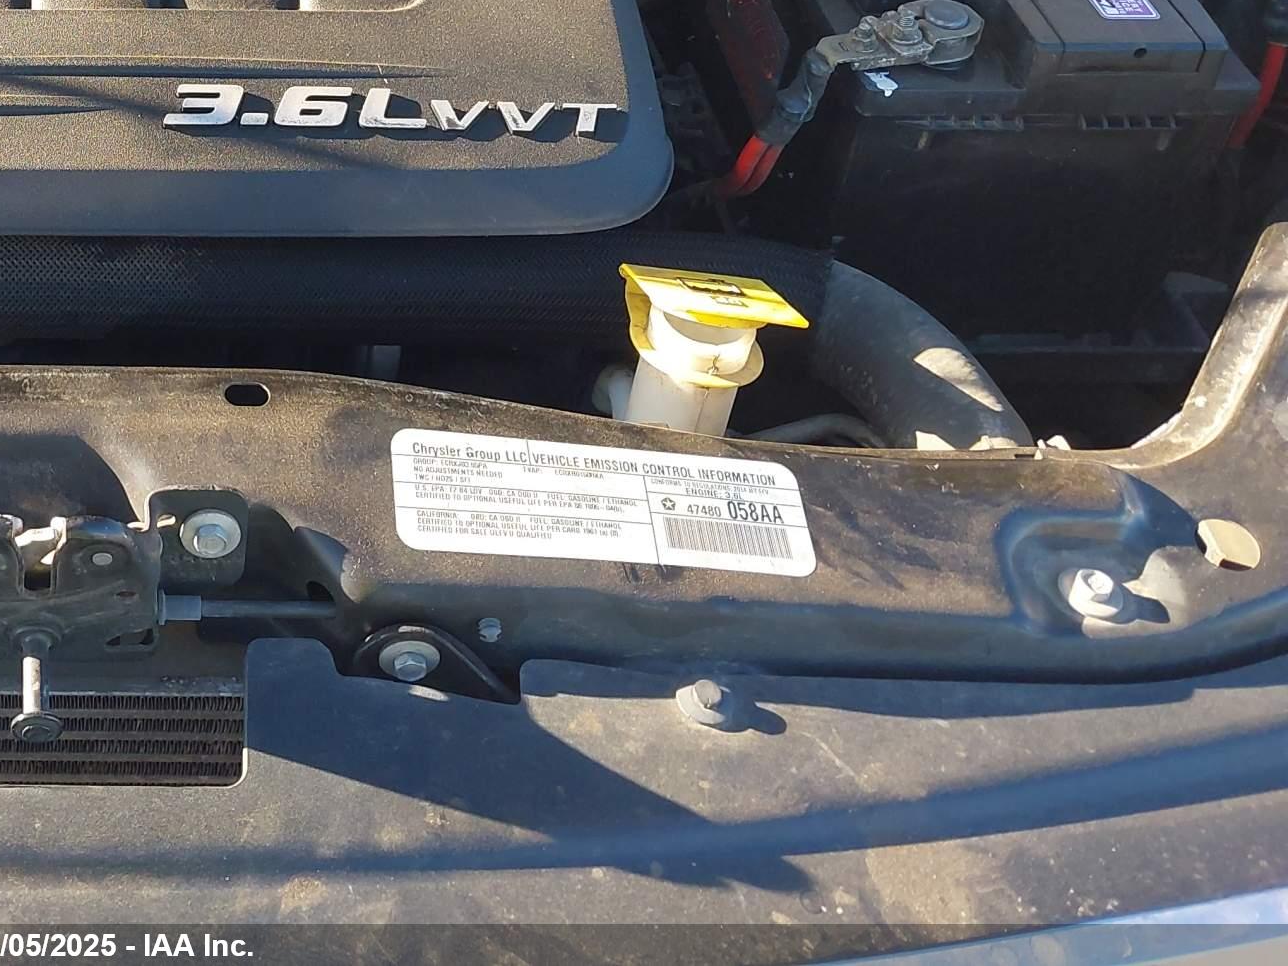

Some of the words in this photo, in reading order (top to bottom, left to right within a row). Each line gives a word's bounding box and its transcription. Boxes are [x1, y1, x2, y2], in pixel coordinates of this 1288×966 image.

[412, 442, 461, 458] Chrysler
[466, 445, 501, 462] Group
[505, 450, 527, 463] LLC
[425, 466, 475, 476] ADJUSTMENTS
[532, 452, 580, 468] VEHICLE
[584, 457, 639, 474] EMISSION
[642, 463, 695, 479] CONTROL
[698, 469, 776, 486] INFORMATION
[463, 495, 496, 503] OPTIONAL
[499, 497, 526, 505] USEFUL
[727, 501, 784, 524] 058AA
[465, 521, 499, 529] OPTIONAL
